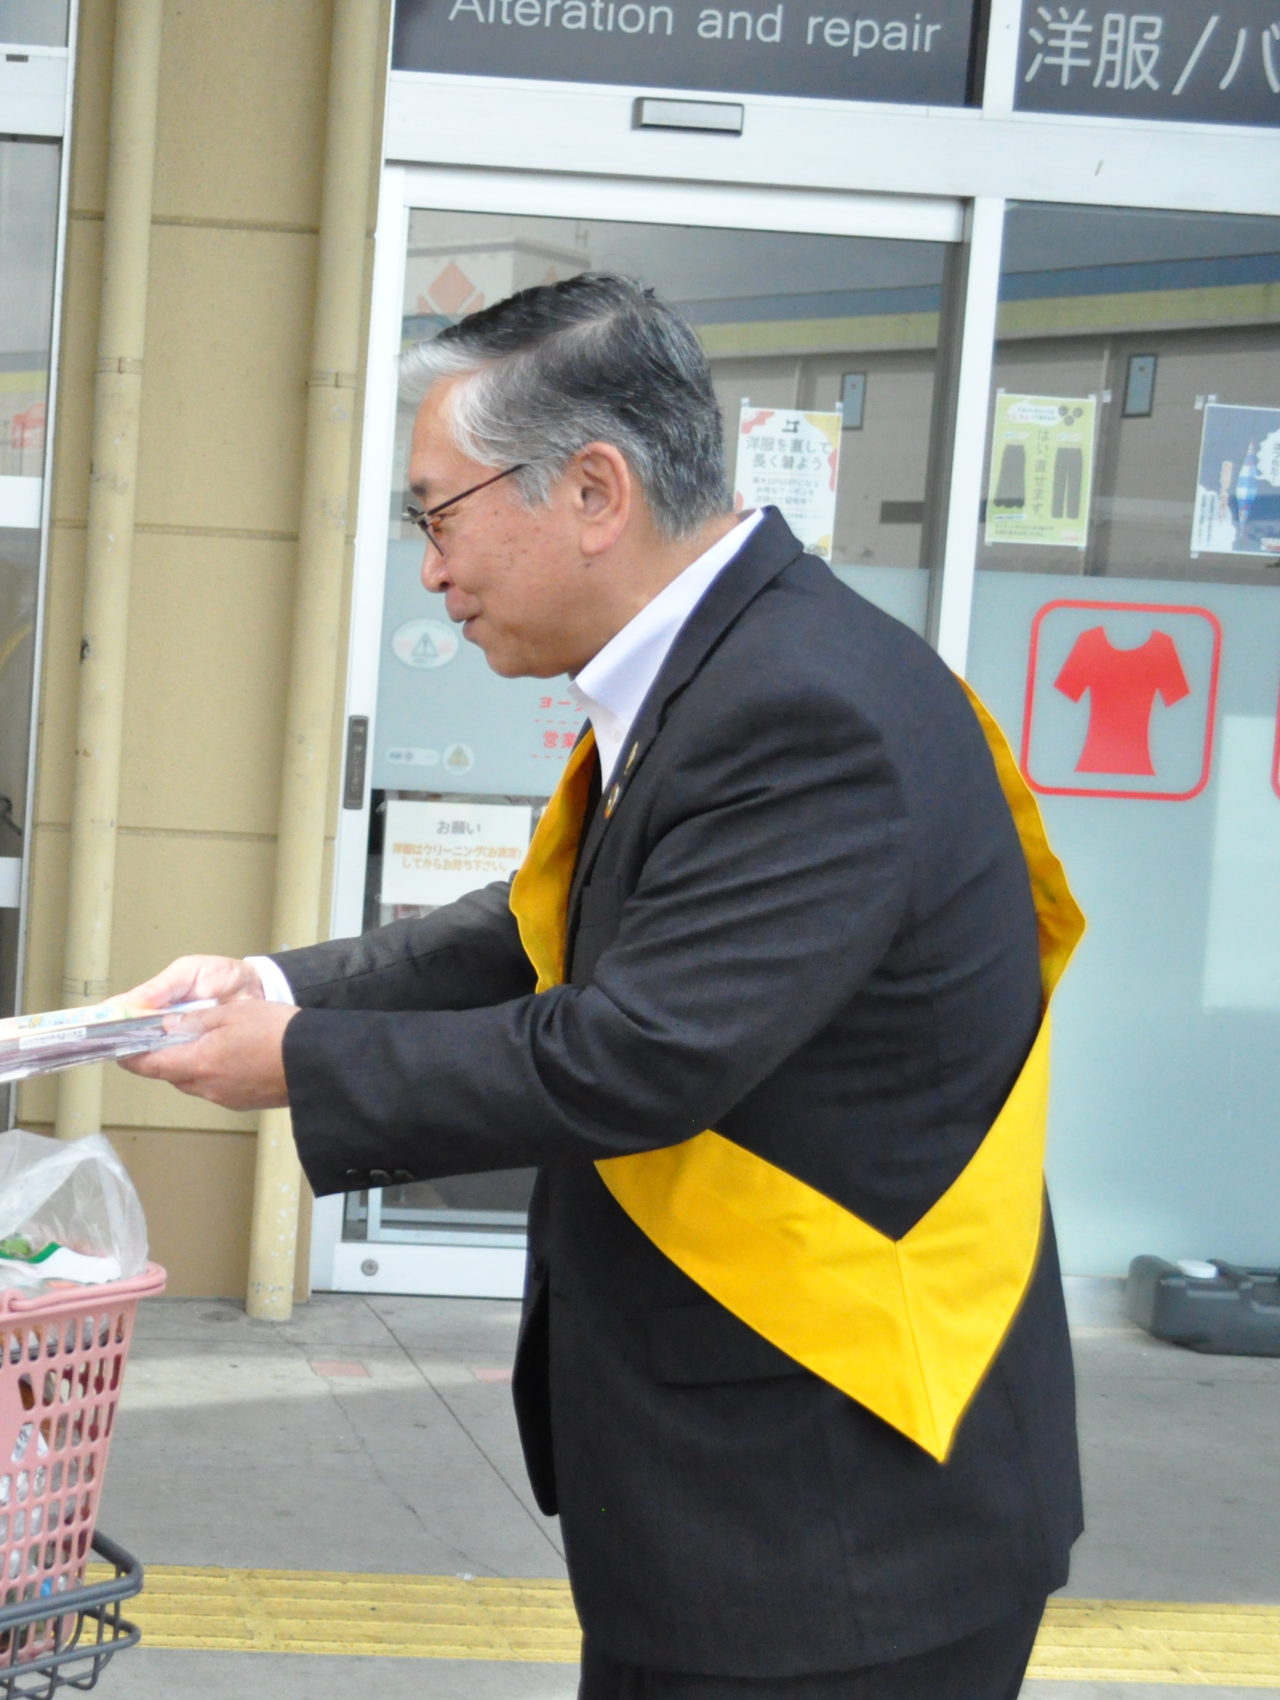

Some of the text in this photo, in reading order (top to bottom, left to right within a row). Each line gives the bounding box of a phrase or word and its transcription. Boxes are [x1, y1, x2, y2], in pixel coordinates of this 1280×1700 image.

[697, 4, 783, 43] and
[806, 13, 941, 57] repair
[436, 820, 481, 835] お願い
